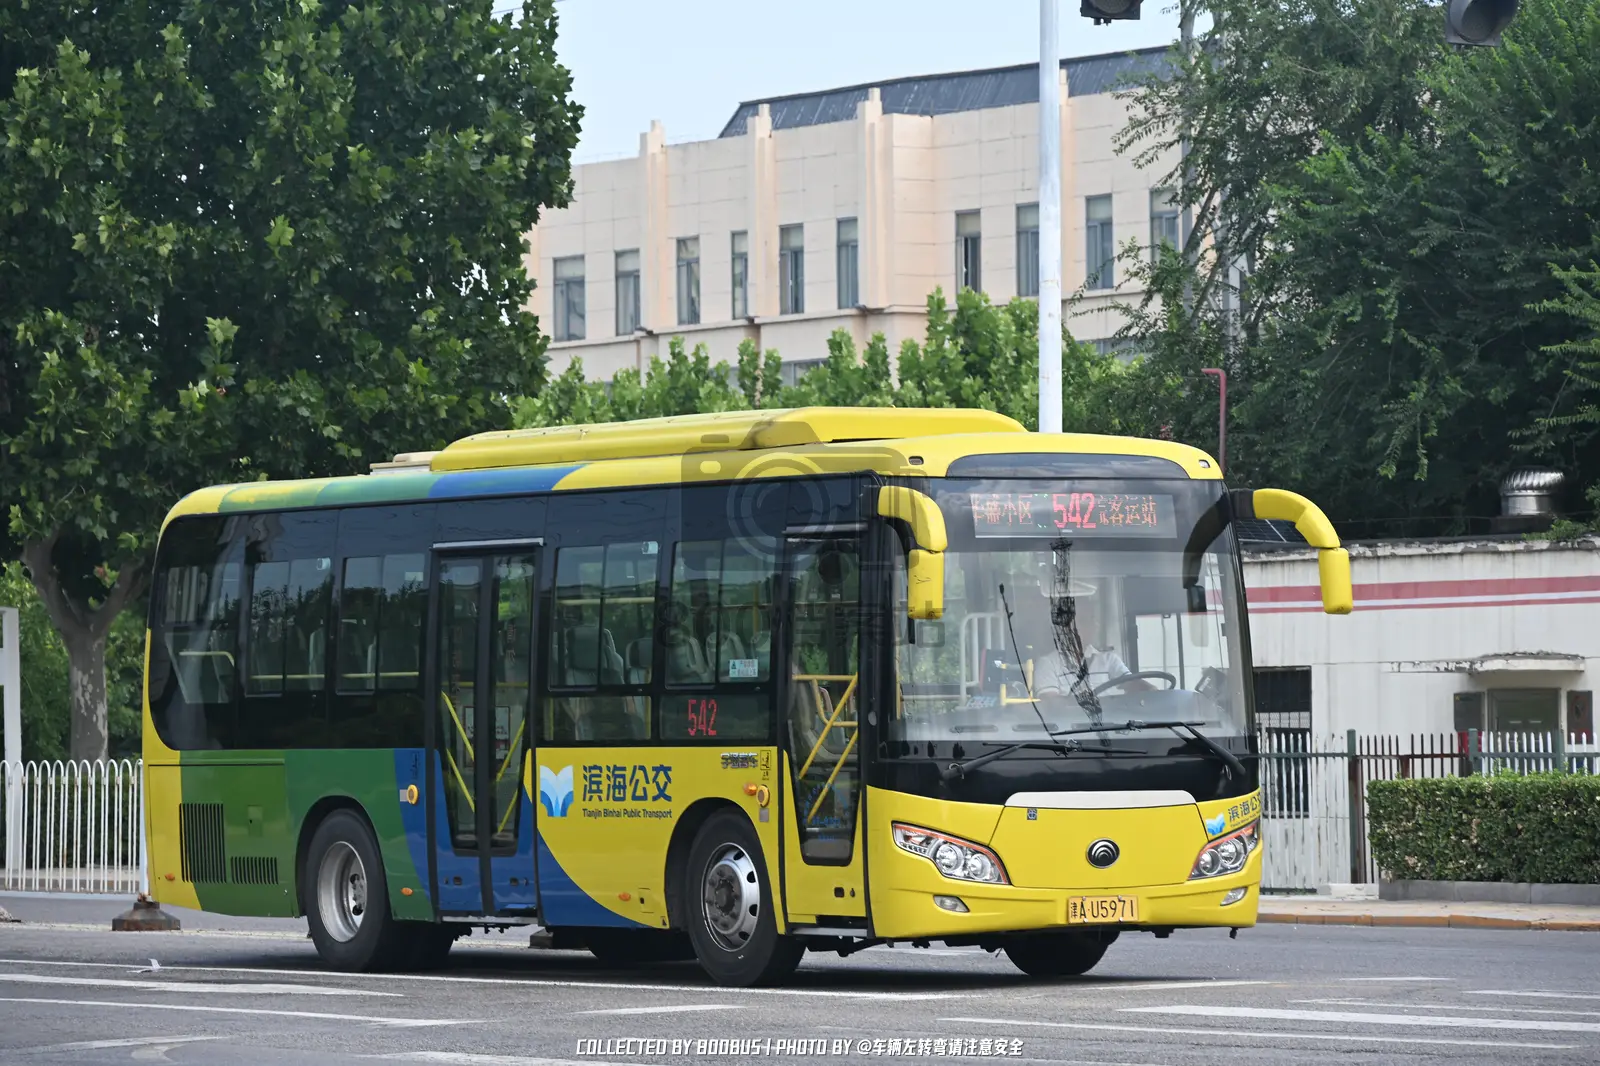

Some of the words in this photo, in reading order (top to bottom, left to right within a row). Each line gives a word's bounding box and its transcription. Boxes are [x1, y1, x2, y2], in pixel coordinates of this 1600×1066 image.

[1053, 493, 1097, 529] 542
[687, 698, 718, 737] 542
[582, 764, 672, 802] 滨海公交
[582, 804, 602, 819] Tianjin
[603, 804, 622, 818] Binhai
[623, 804, 641, 818] Public
[642, 804, 673, 820] Transport
